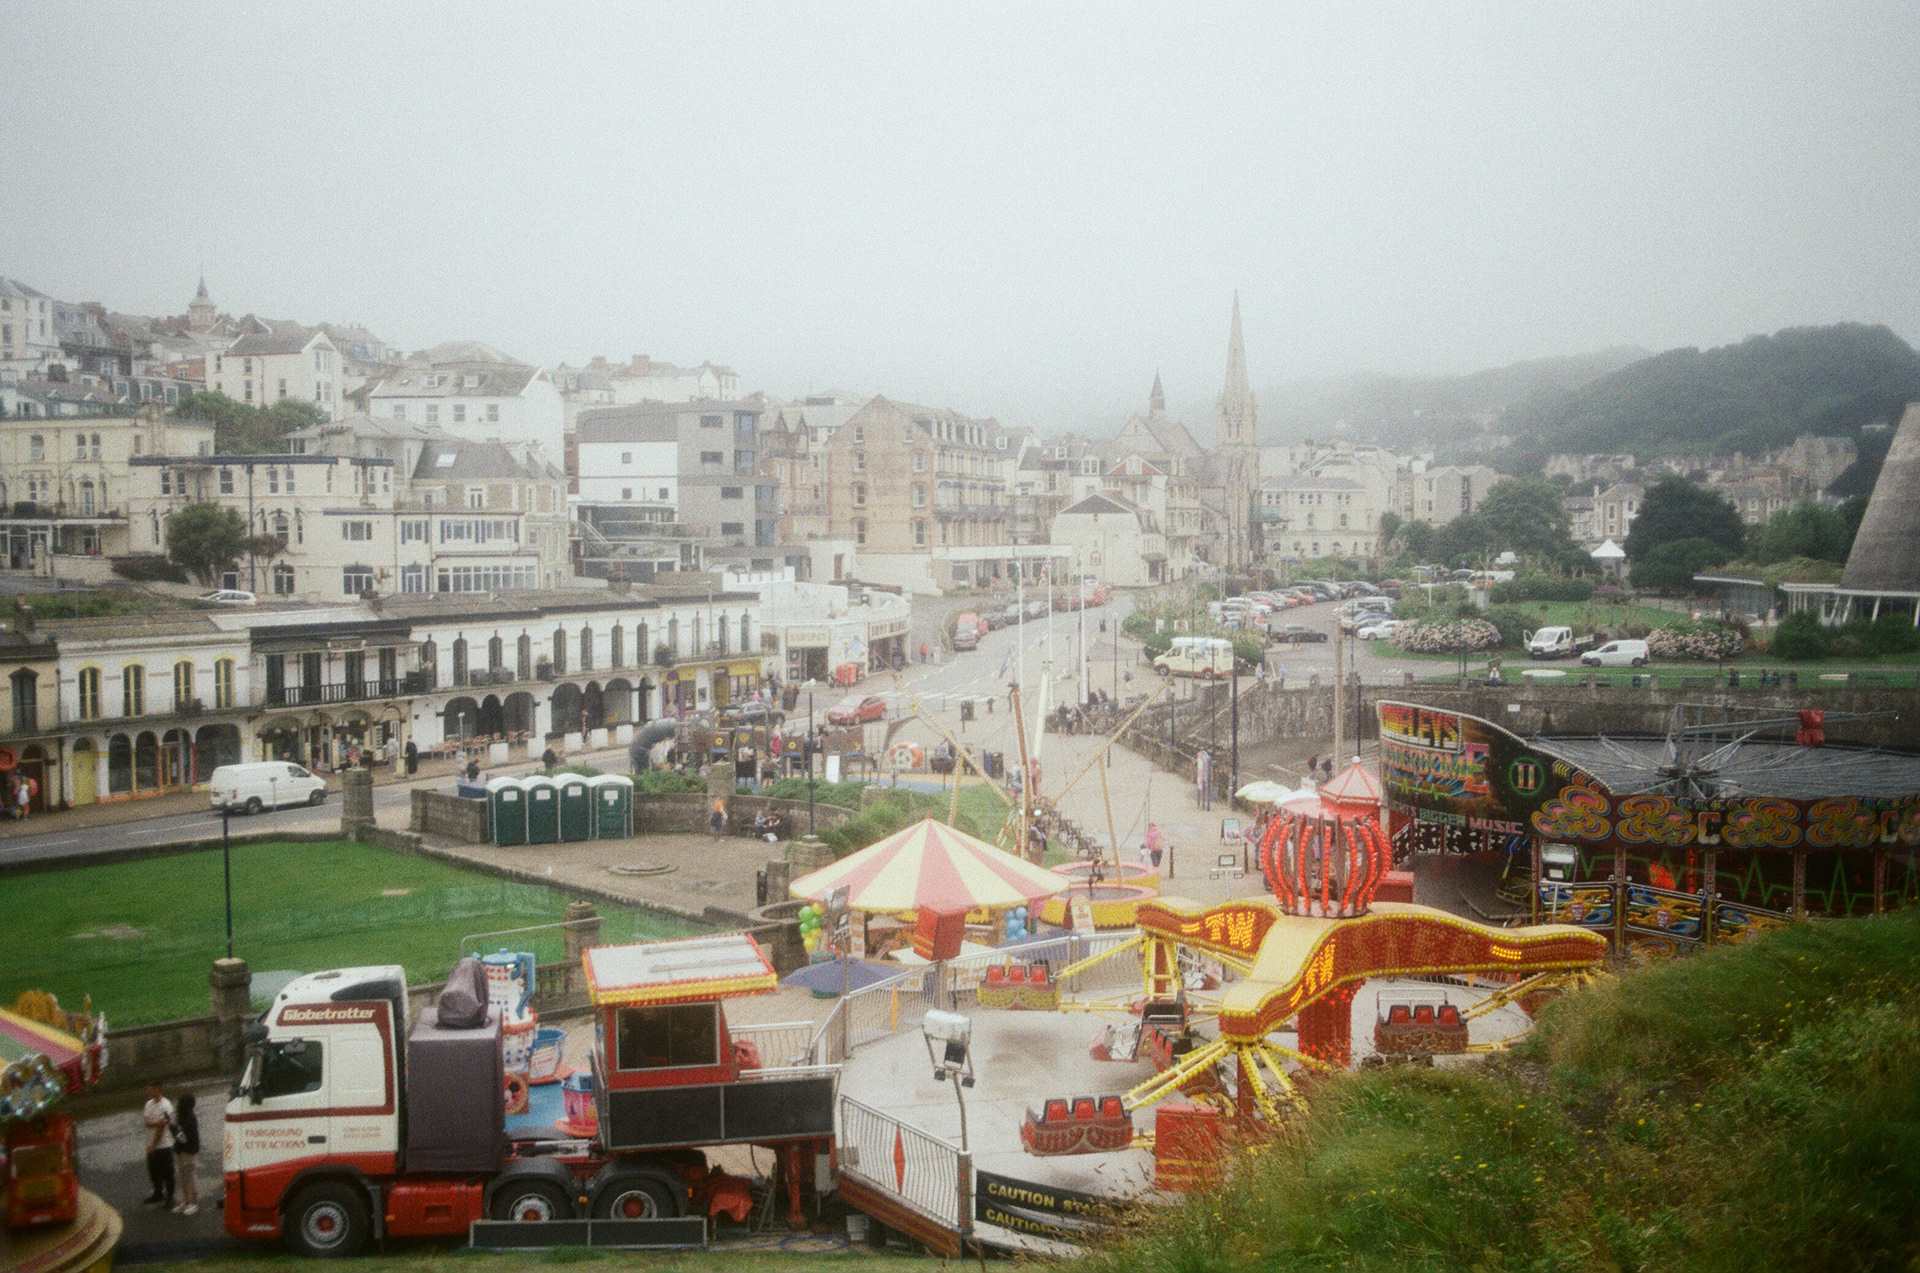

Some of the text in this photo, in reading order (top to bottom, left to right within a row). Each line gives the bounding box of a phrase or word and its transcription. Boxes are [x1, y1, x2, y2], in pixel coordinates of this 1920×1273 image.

[1419, 808, 1466, 828] BIGGER
[1469, 817, 1523, 834] MUSIC
[283, 1007, 376, 1021] Globetrotter
[988, 1182, 1055, 1208] CAUTION
